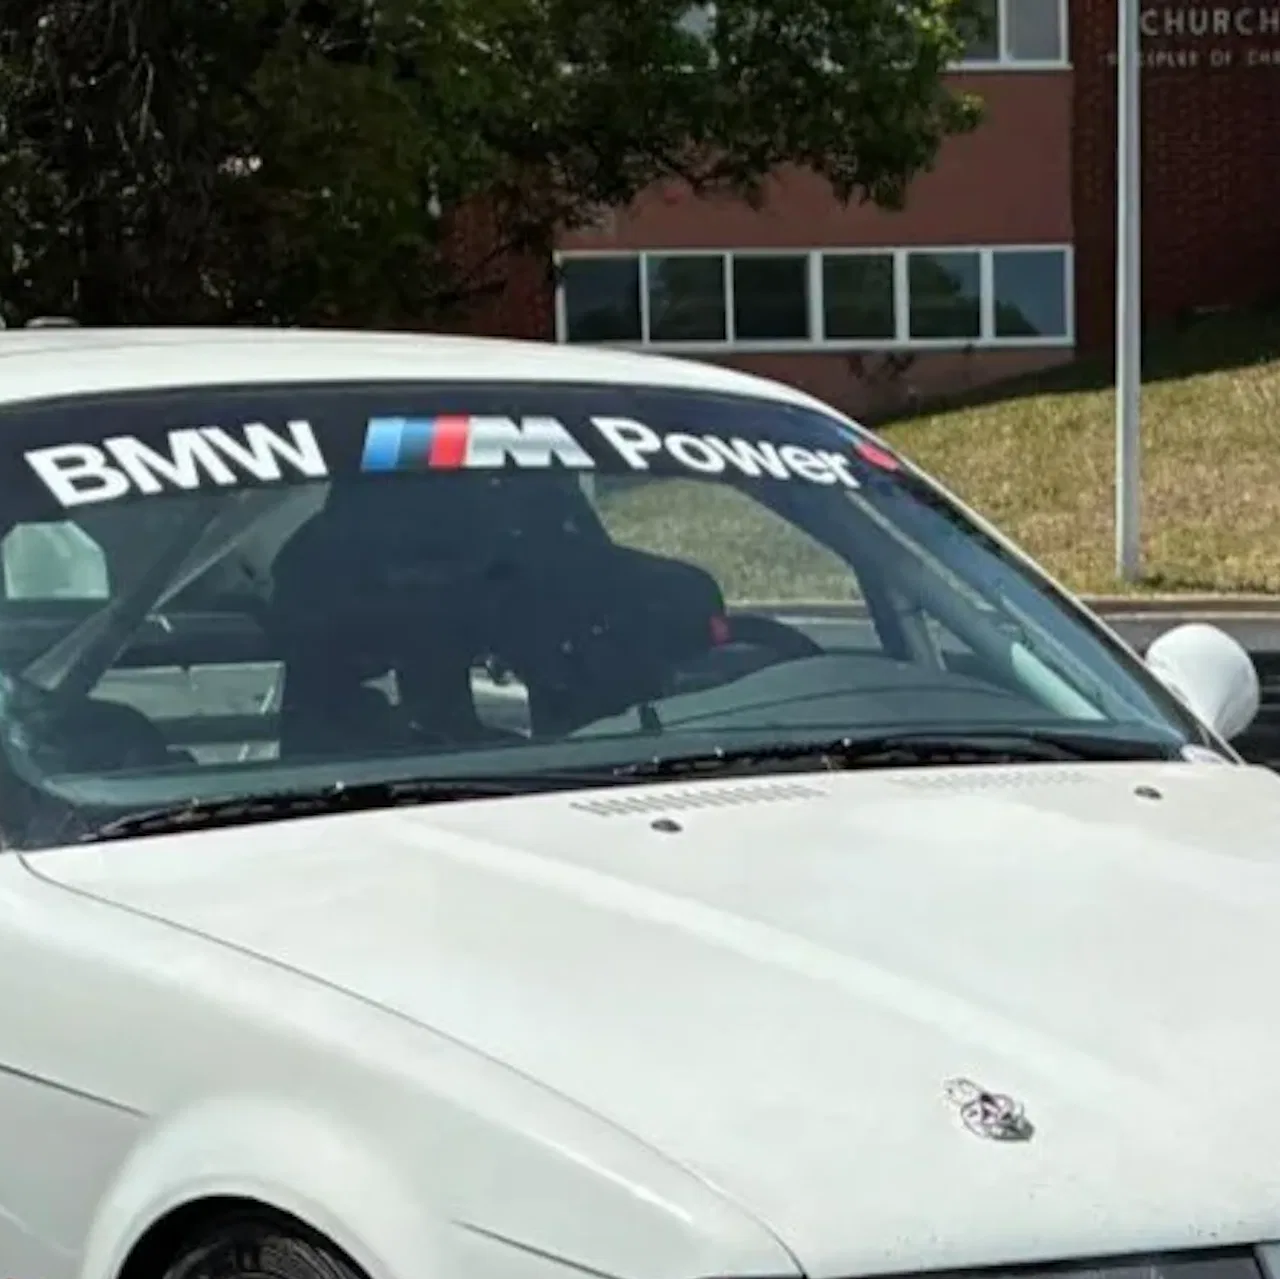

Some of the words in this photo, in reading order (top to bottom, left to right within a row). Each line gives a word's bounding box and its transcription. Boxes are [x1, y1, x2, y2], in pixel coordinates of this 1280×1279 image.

[1140, 8, 1280, 36] CHURCH
[23, 420, 328, 508] BMW
[591, 416, 862, 489] Power
